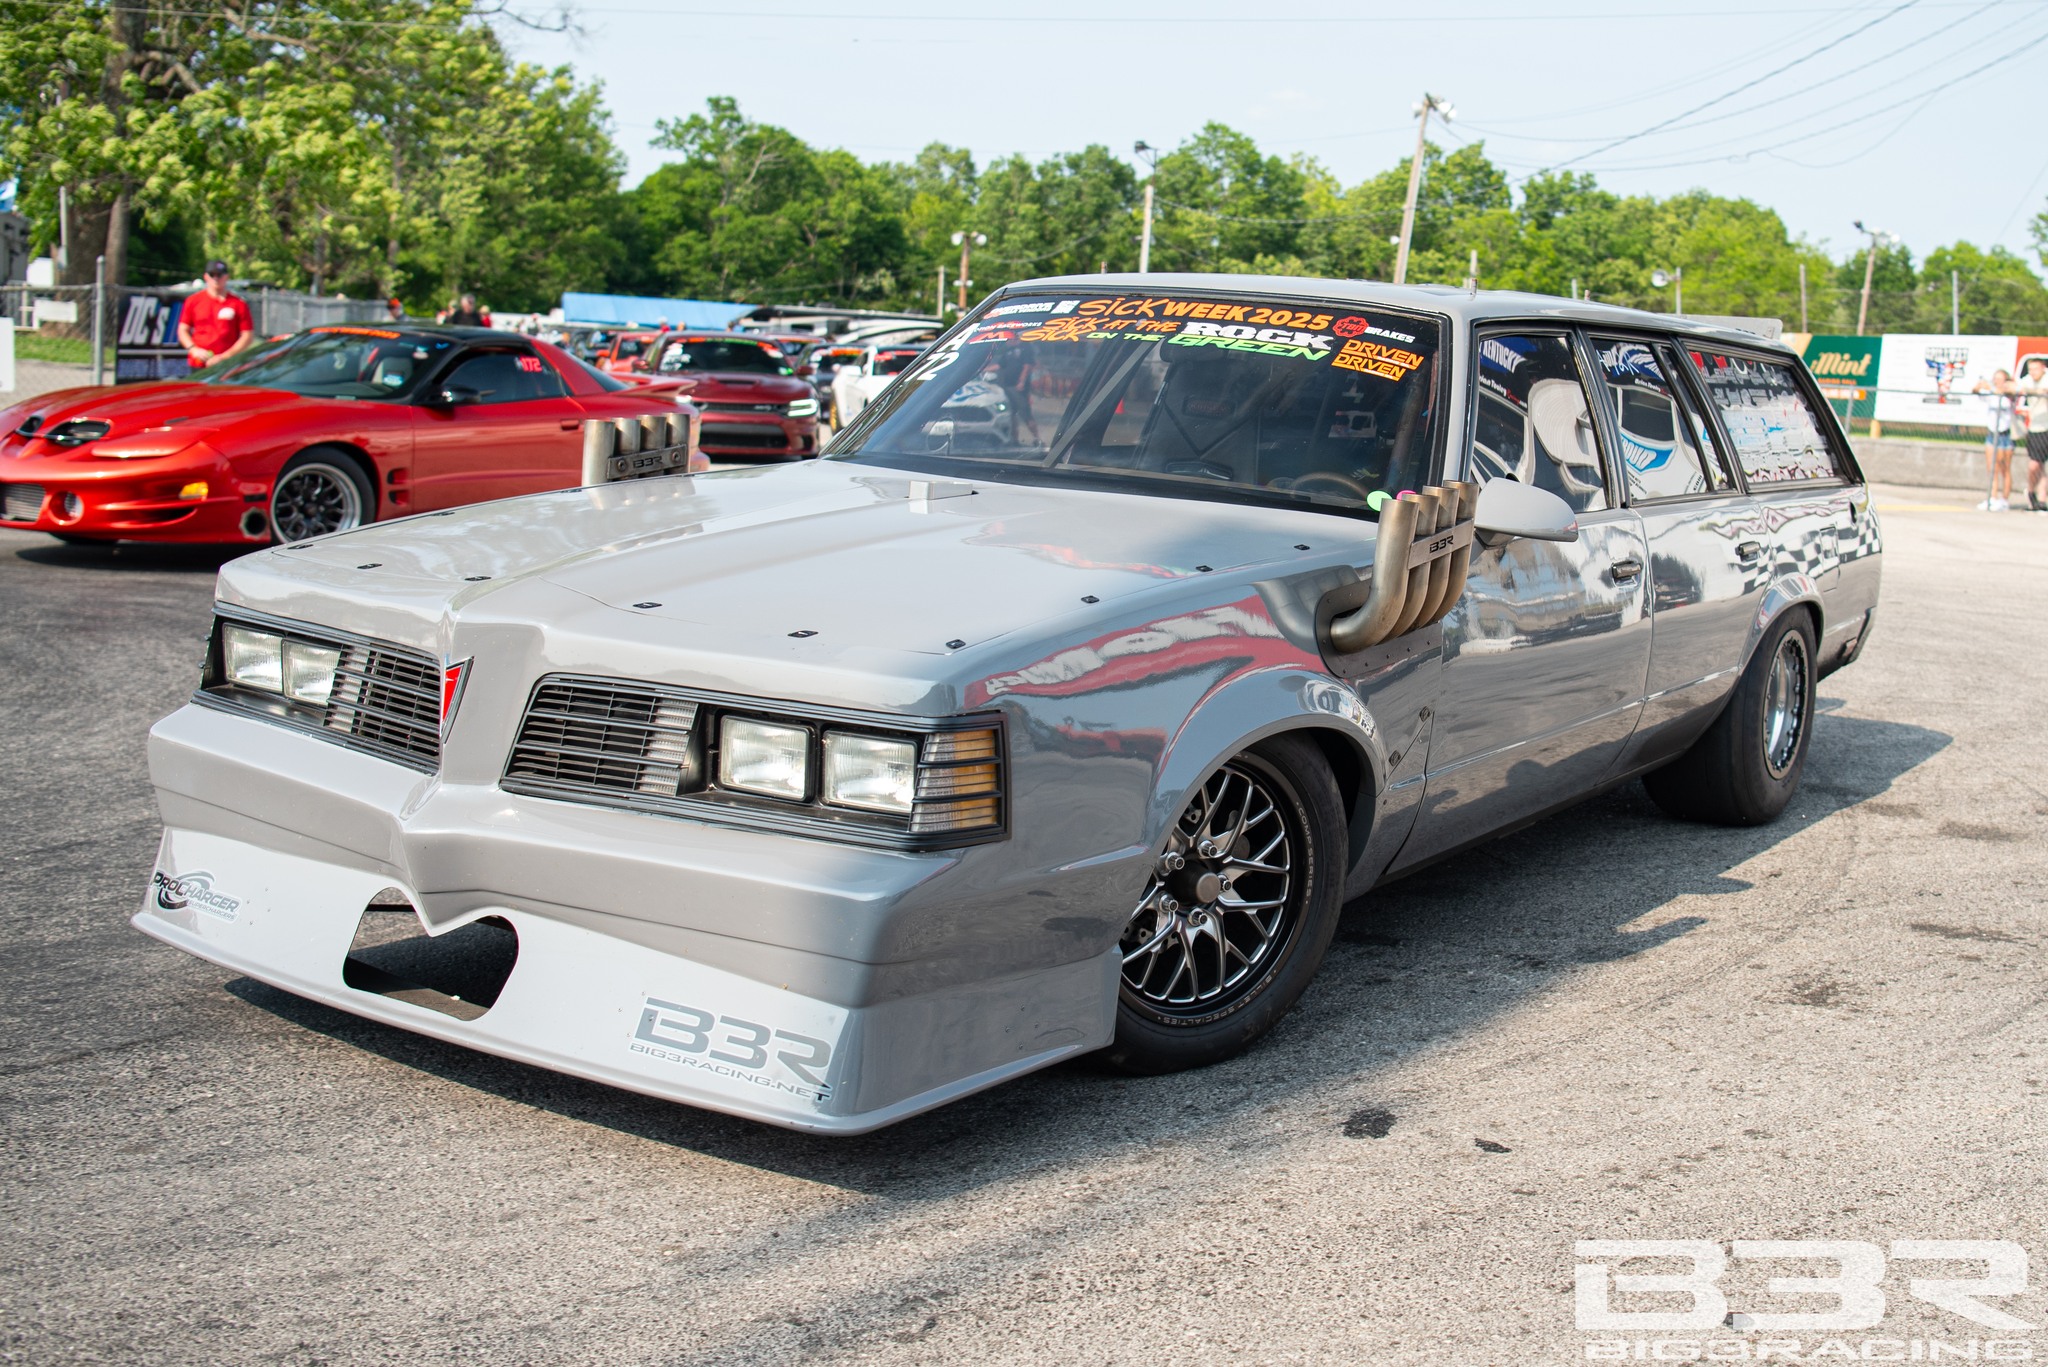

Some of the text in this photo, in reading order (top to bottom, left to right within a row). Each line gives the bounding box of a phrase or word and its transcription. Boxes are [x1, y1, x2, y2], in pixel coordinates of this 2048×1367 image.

[1078, 297, 1170, 318] SICK
[1163, 301, 1253, 323] WEEK
[1248, 307, 1334, 331] 2025
[1020, 329, 1098, 342] SICK
[1087, 332, 1123, 340] ON
[1124, 333, 1166, 342] THE
[1167, 333, 1331, 361] GREEN
[1043, 316, 1335, 350] SICK AT THE ROCK
[1364, 326, 1416, 344] BRAKES
[1331, 353, 1407, 382] DRIVEN
[1341, 339, 1424, 371] DRIVEN
[1482, 339, 1528, 374] KENTUCKY
[1814, 352, 1872, 376] Mint
[633, 456, 663, 469] B3R
[1429, 535, 1454, 553] B3R
[1298, 807, 1314, 897] COMP SERIES
[1162, 1006, 1236, 1026] SPECIALTIES
[634, 997, 833, 1090] B3R
[629, 1042, 831, 1102] BIG3RACING.NET
